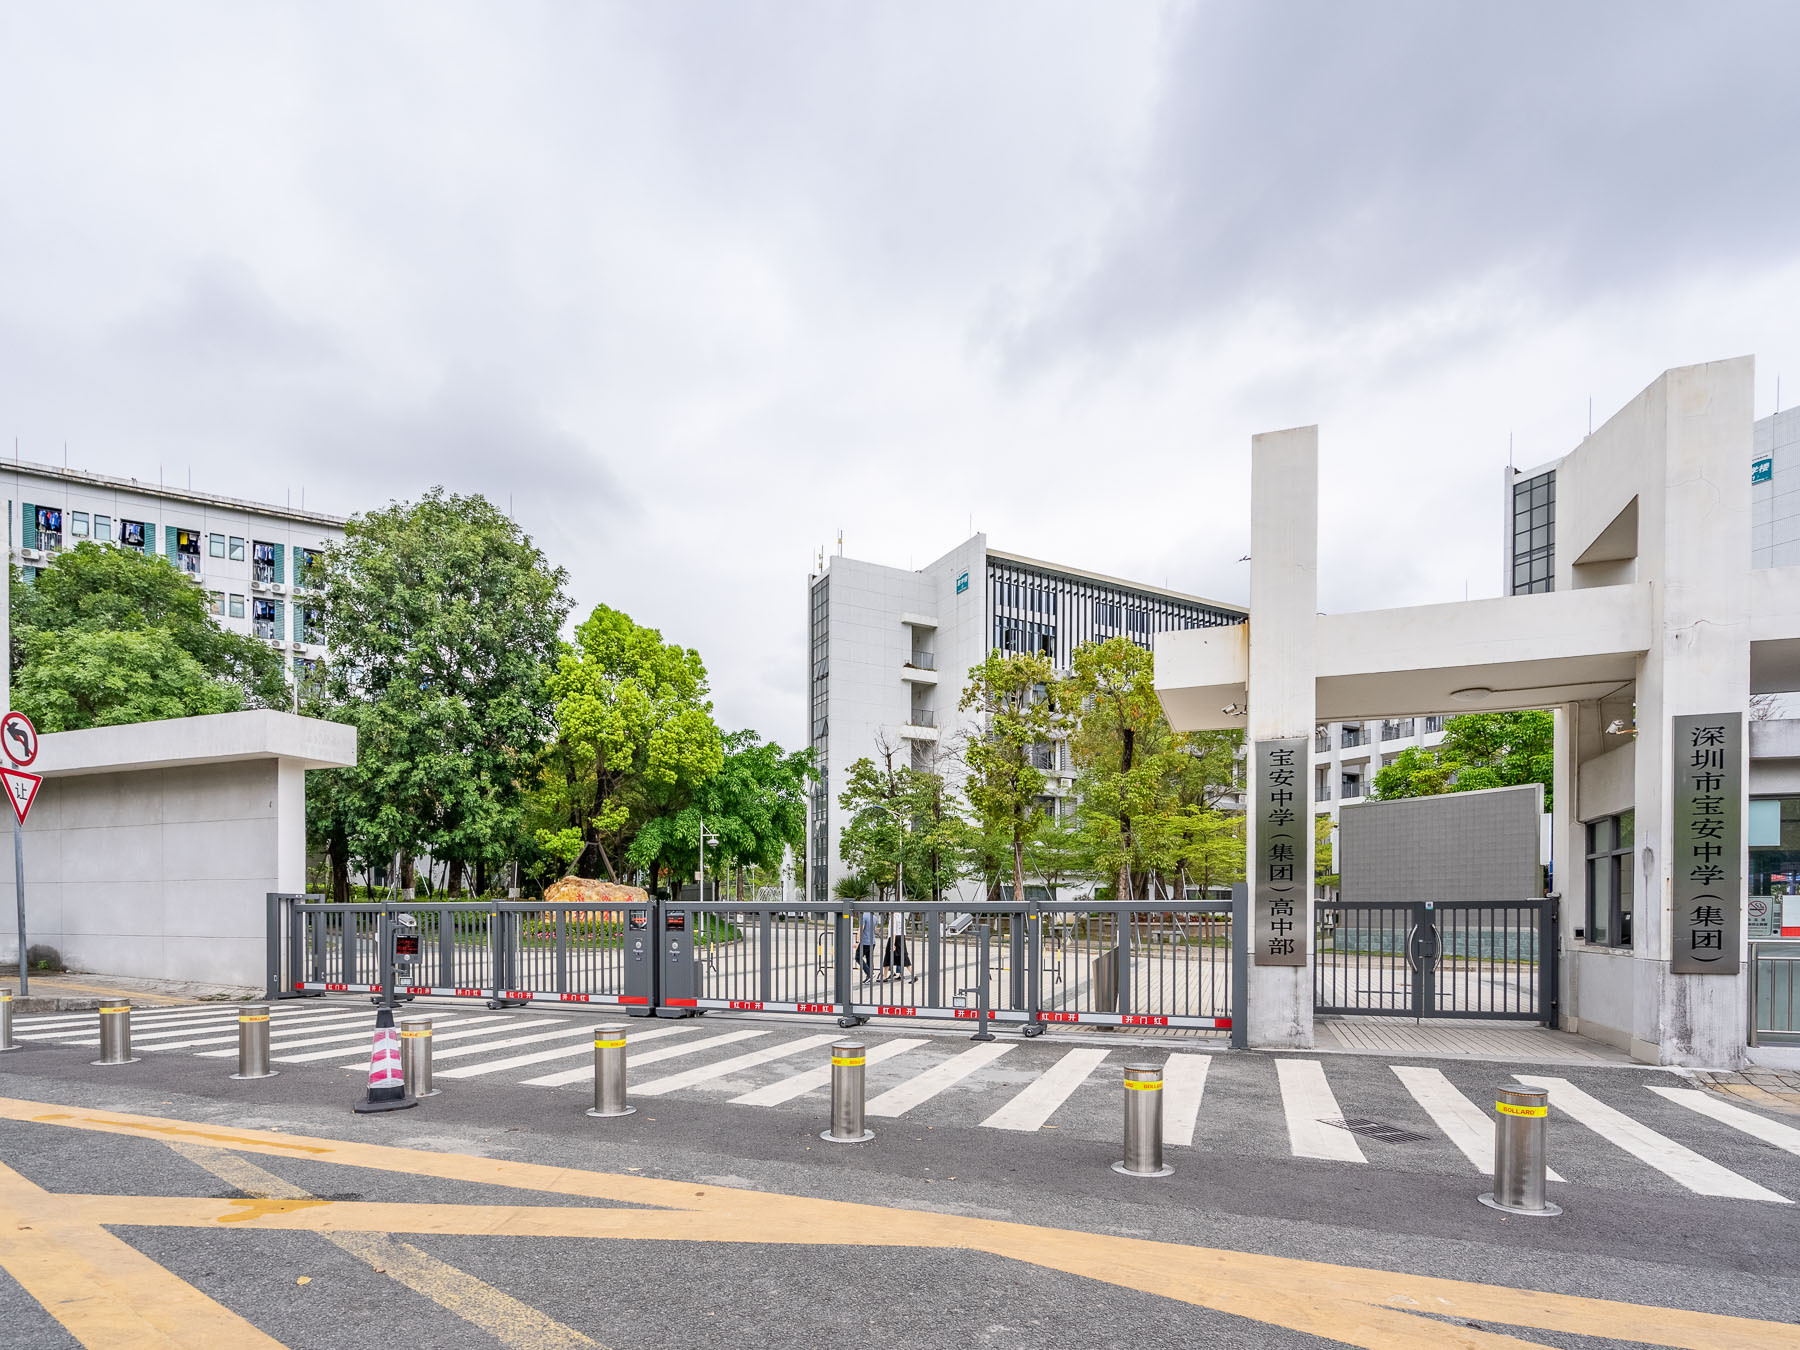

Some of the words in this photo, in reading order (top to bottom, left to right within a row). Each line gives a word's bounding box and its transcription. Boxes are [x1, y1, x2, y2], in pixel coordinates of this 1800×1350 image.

[15, 782, 28, 801] 让
[1690, 726, 1726, 963] 深圳市宝安中学（集团）
[1268, 749, 1296, 956] 宝安中学（集团）高中部
[509, 991, 532, 999] 红门开
[799, 1004, 829, 1012] 开门红
[882, 1007, 914, 1015] 红门开
[1041, 1012, 1076, 1021] 红门开
[1125, 1015, 1162, 1025] 开门红
[1503, 1106, 1536, 1116] BOLLARD
